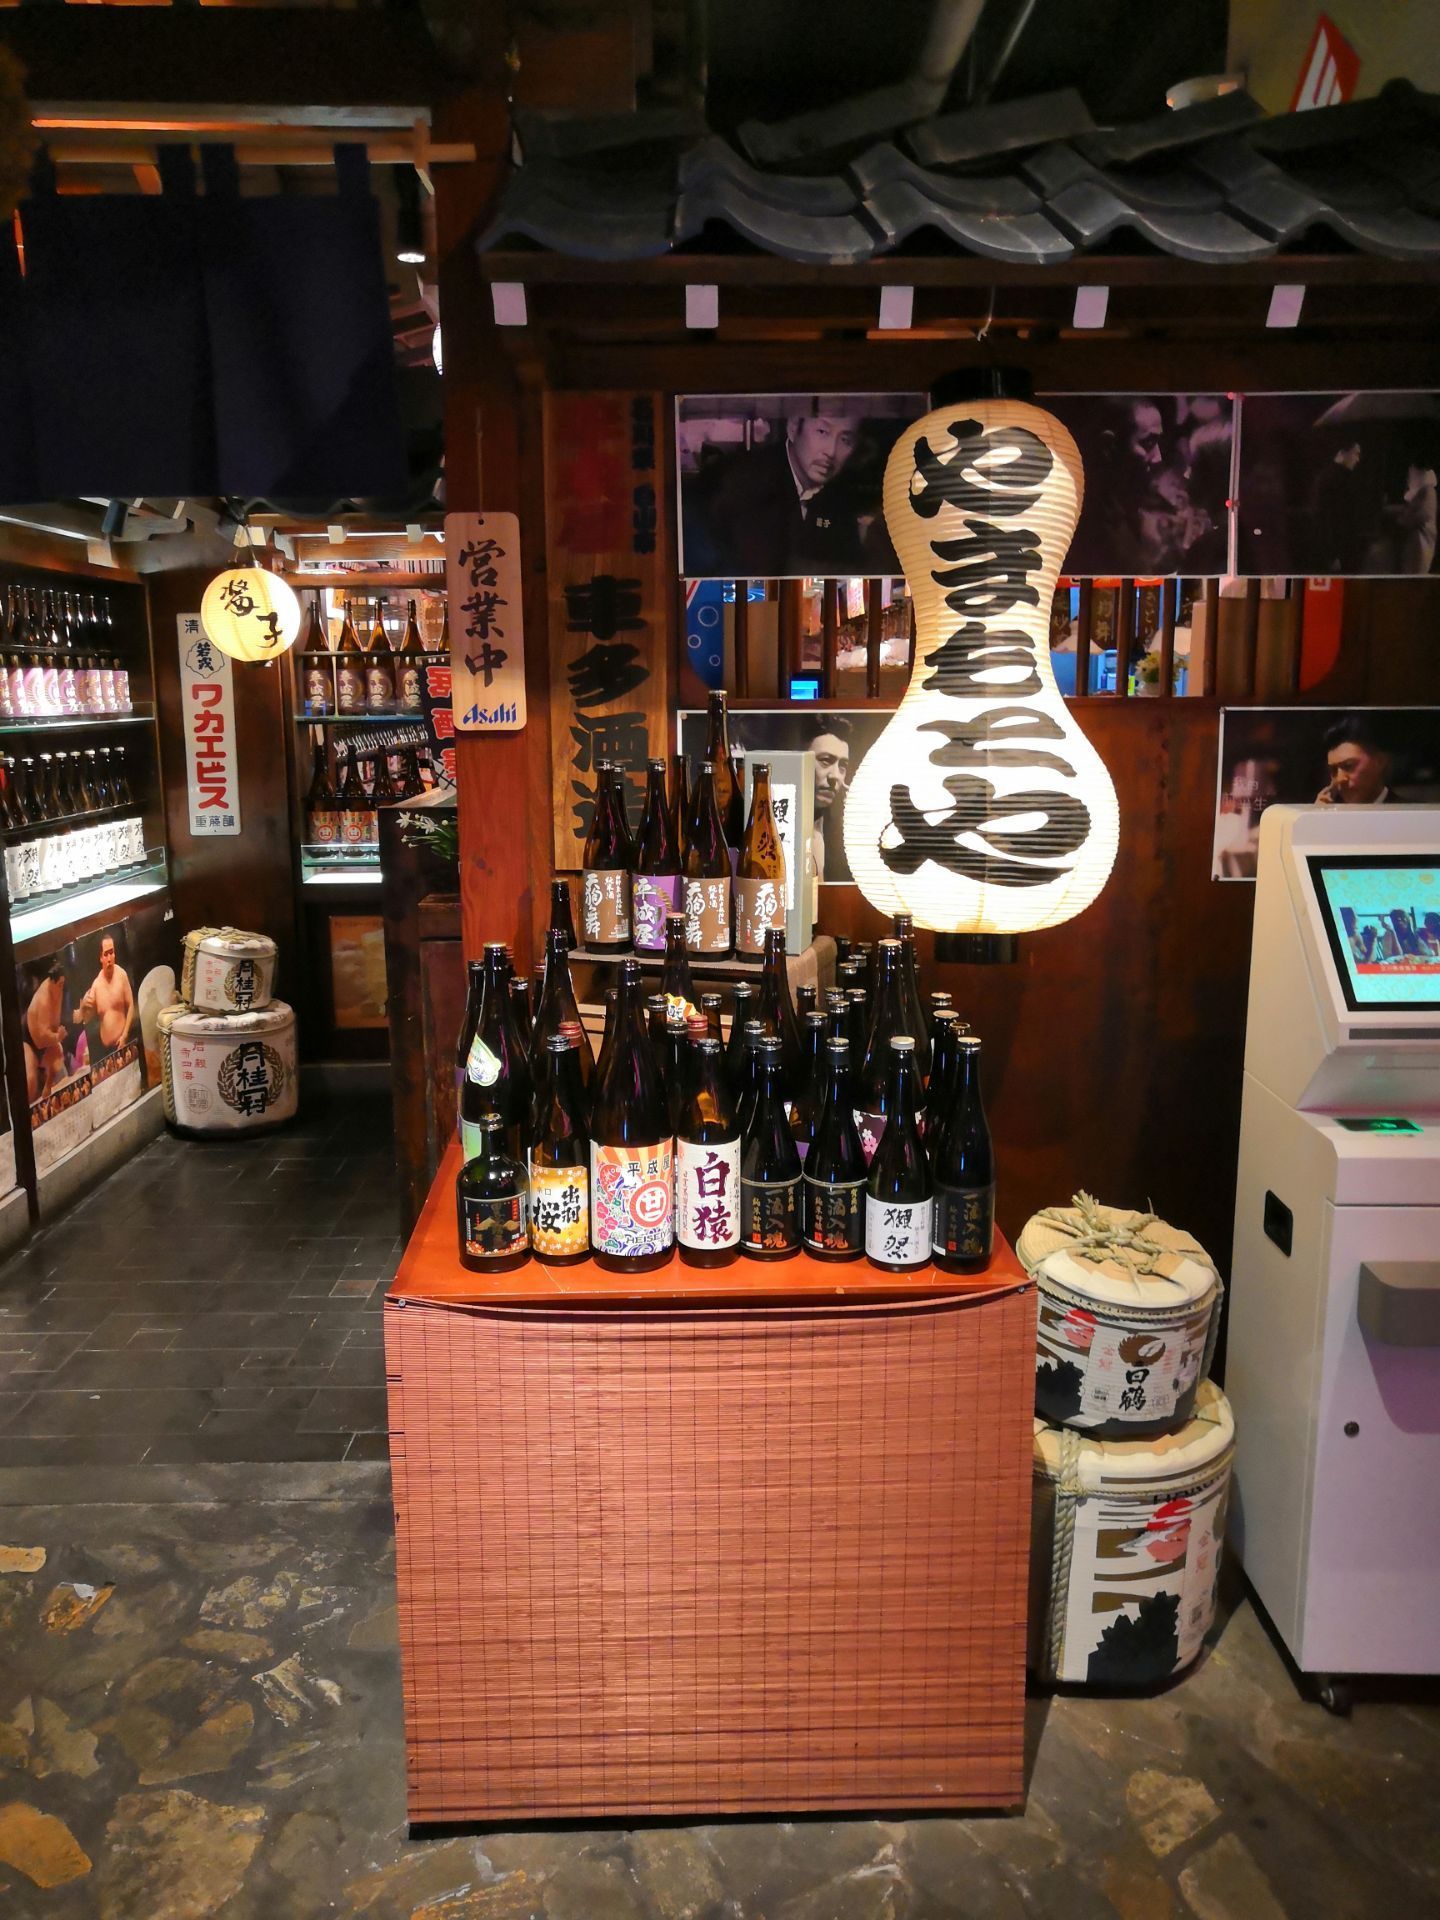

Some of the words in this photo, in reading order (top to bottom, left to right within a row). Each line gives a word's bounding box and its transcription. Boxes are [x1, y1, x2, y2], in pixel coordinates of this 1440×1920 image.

[458, 538, 508, 688] 営業中
[462, 701, 518, 725] Asahi
[192, 683, 229, 809] ワカエビス
[635, 877, 657, 946] 平成屋
[234, 959, 255, 1010] 月桂冠
[235, 1041, 269, 1116] 月桂冠
[627, 1154, 671, 1177] 平成屋
[692, 1150, 733, 1244] 白猿
[883, 1208, 913, 1260] 獺祭
[1119, 1368, 1150, 1412] 白鶴
